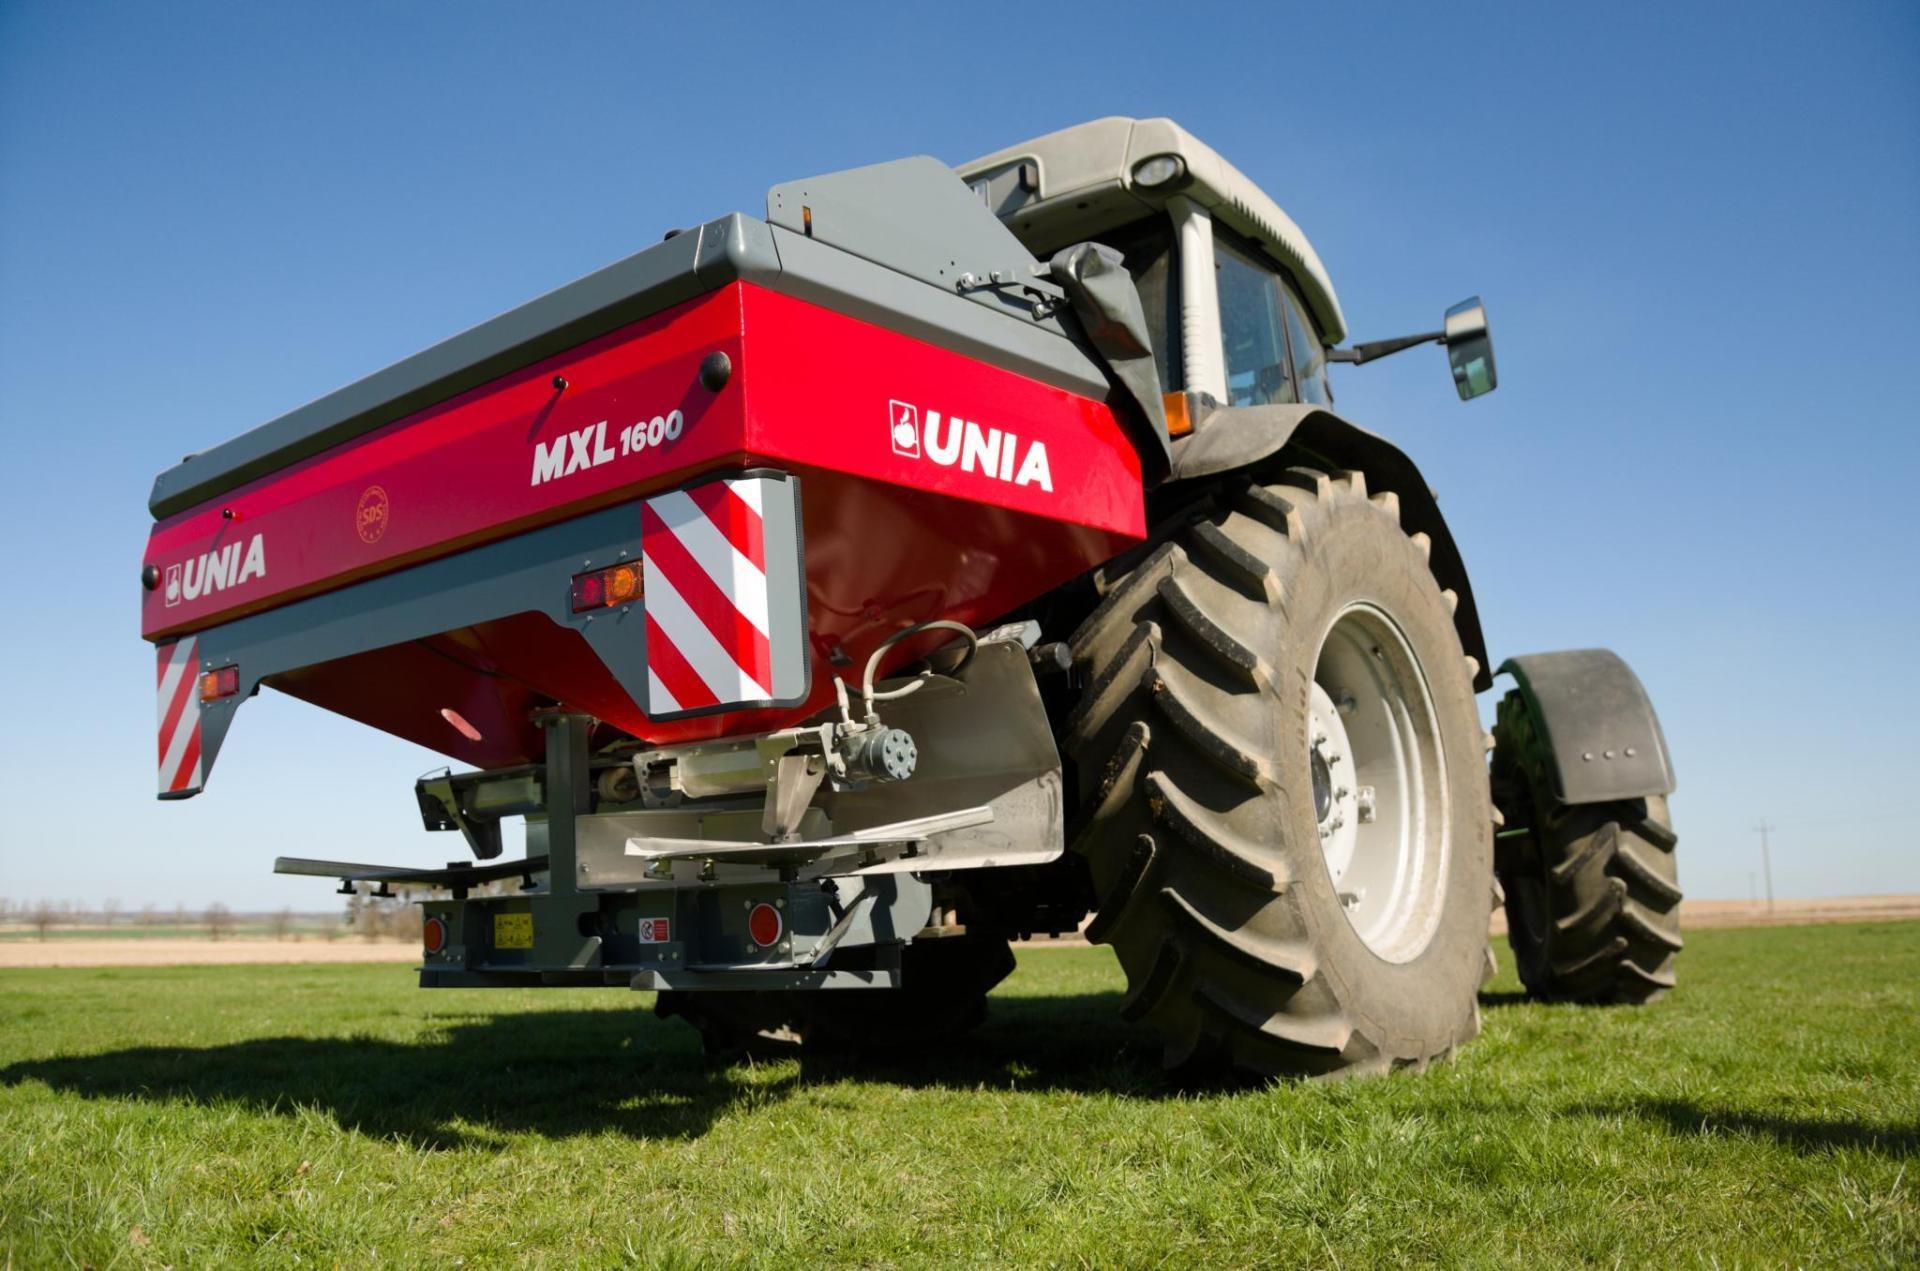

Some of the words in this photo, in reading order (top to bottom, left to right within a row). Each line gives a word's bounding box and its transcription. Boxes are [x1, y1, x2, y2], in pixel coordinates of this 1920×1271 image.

[531, 420, 615, 486] MXL
[620, 409, 683, 456] 1600
[924, 409, 1053, 493] UNIA
[183, 533, 266, 600] UNIA
